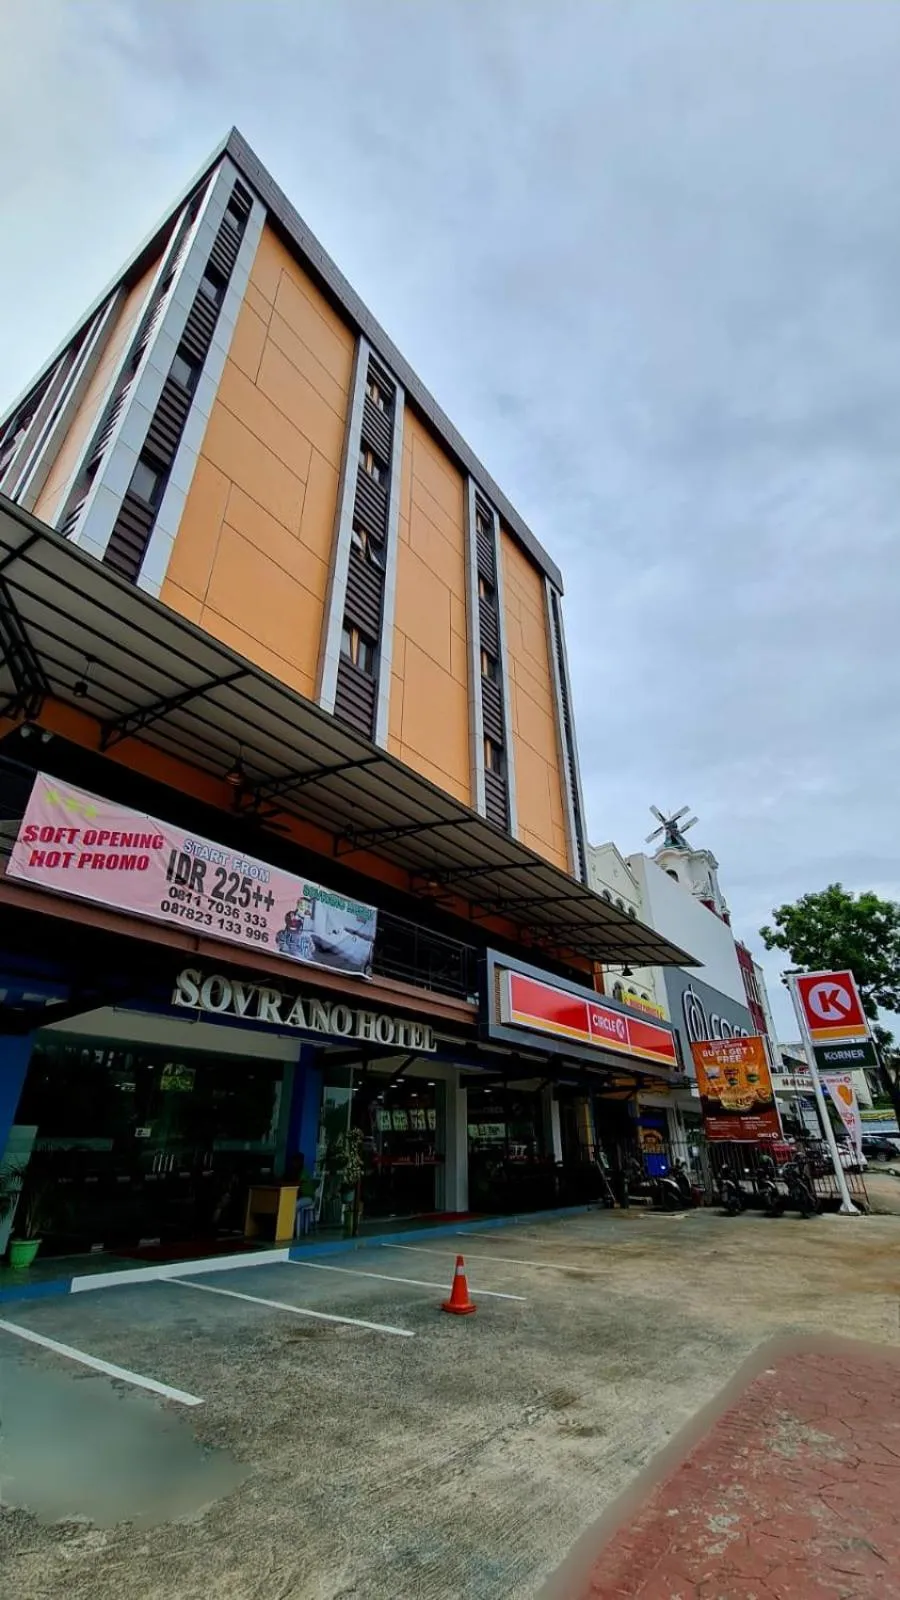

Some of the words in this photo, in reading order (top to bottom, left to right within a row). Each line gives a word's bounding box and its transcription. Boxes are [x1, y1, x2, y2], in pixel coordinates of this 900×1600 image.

[23, 824, 81, 845] SOFT
[82, 829, 164, 850] OPENING
[29, 850, 73, 869] HOT
[77, 852, 150, 872] PROMO
[183, 838, 230, 866] START
[232, 858, 270, 883] FROM
[165, 848, 208, 894] IDR
[213, 867, 275, 913] 225++
[160, 899, 213, 926] 087823
[217, 918, 243, 935] 133
[245, 927, 270, 944] 996
[168, 885, 202, 908] 0811
[207, 898, 241, 919] 7036
[244, 910, 268, 928] 333
[173, 968, 353, 1036] SOVRANO
[355, 1010, 437, 1052] HOTEL
[817, 990, 850, 1019] K
[592, 1014, 616, 1034] CIRCLE
[716, 1055, 743, 1064] FREE
